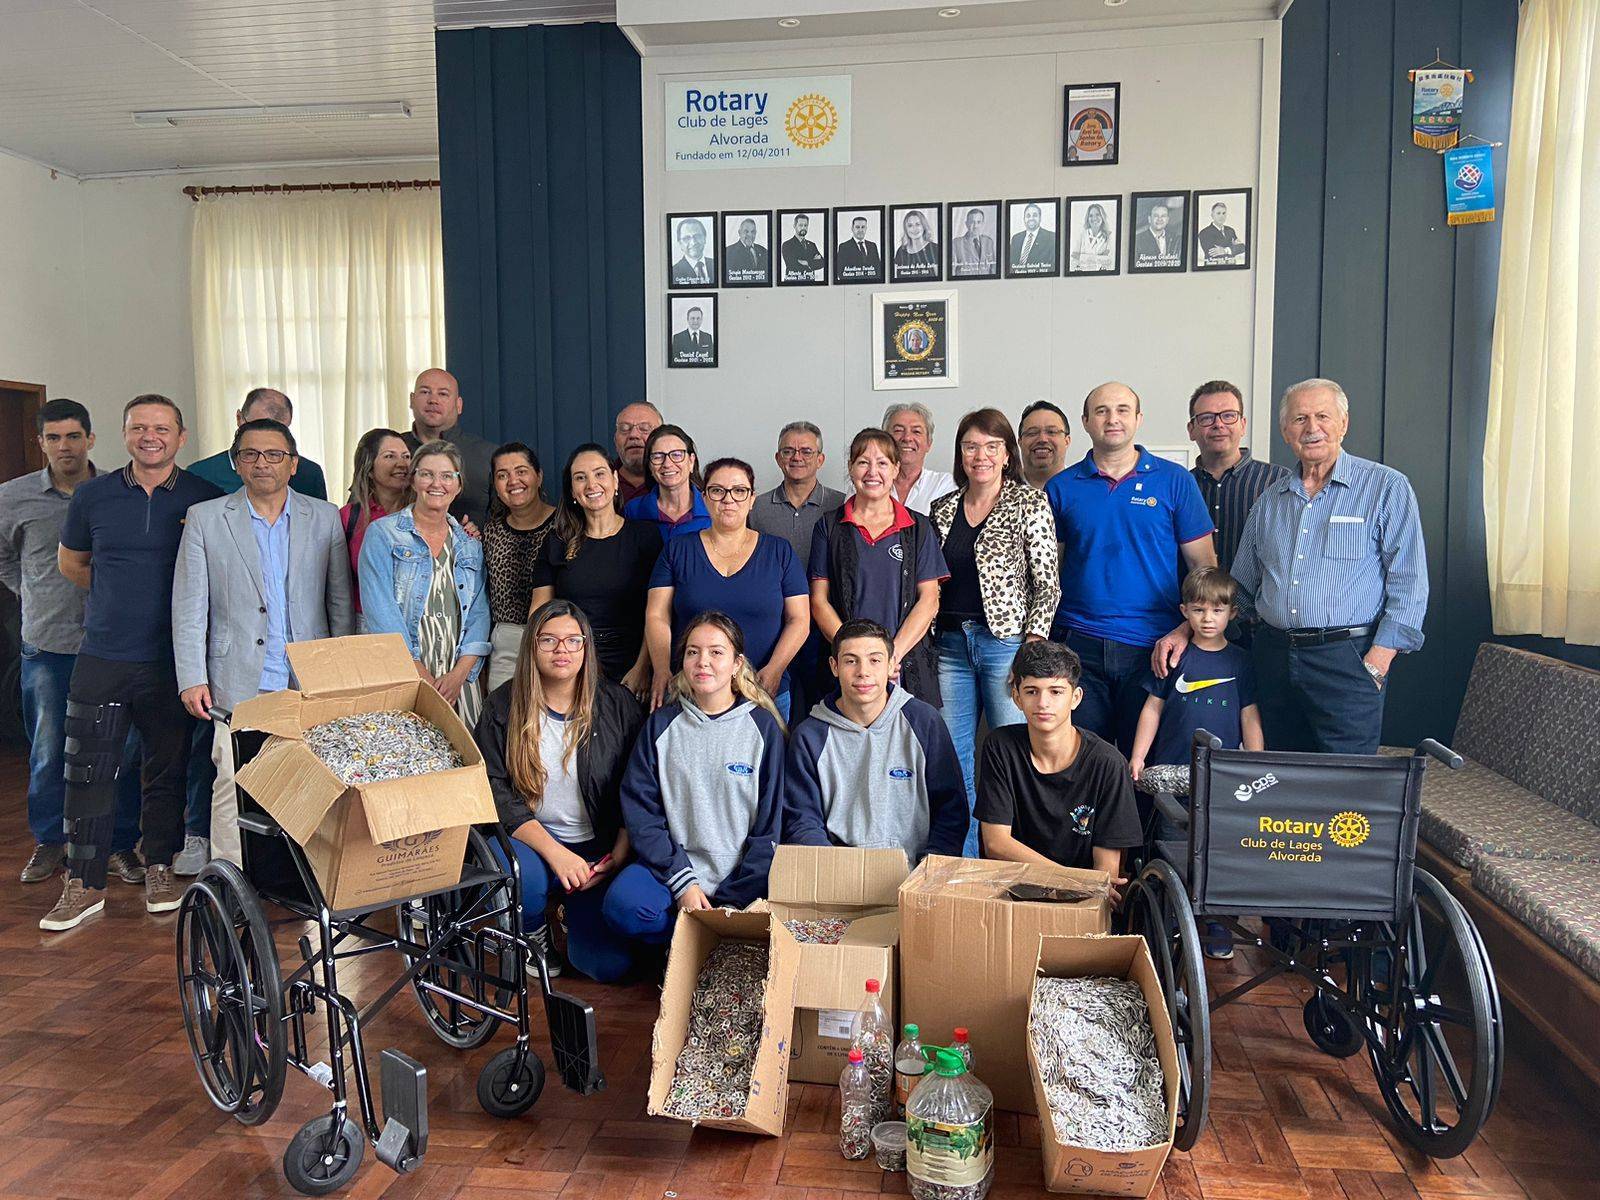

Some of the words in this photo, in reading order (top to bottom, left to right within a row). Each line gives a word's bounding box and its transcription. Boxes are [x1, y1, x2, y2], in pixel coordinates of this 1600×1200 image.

[686, 89, 768, 115] Rotary
[677, 115, 706, 129] Club
[710, 114, 726, 127] de
[731, 114, 768, 129] Lages
[709, 131, 768, 146] Alvorada
[675, 151, 716, 161] Fundado
[718, 151, 733, 160] em
[737, 147, 790, 160] 12/04/2011
[1181, 695, 1228, 707] NIKE
[1251, 772, 1276, 791] CDS
[1259, 816, 1324, 838] Rotary
[1240, 837, 1267, 848] Club
[1270, 838, 1285, 849] de
[1289, 839, 1323, 852] Lages
[1267, 850, 1322, 863] Alvorada
